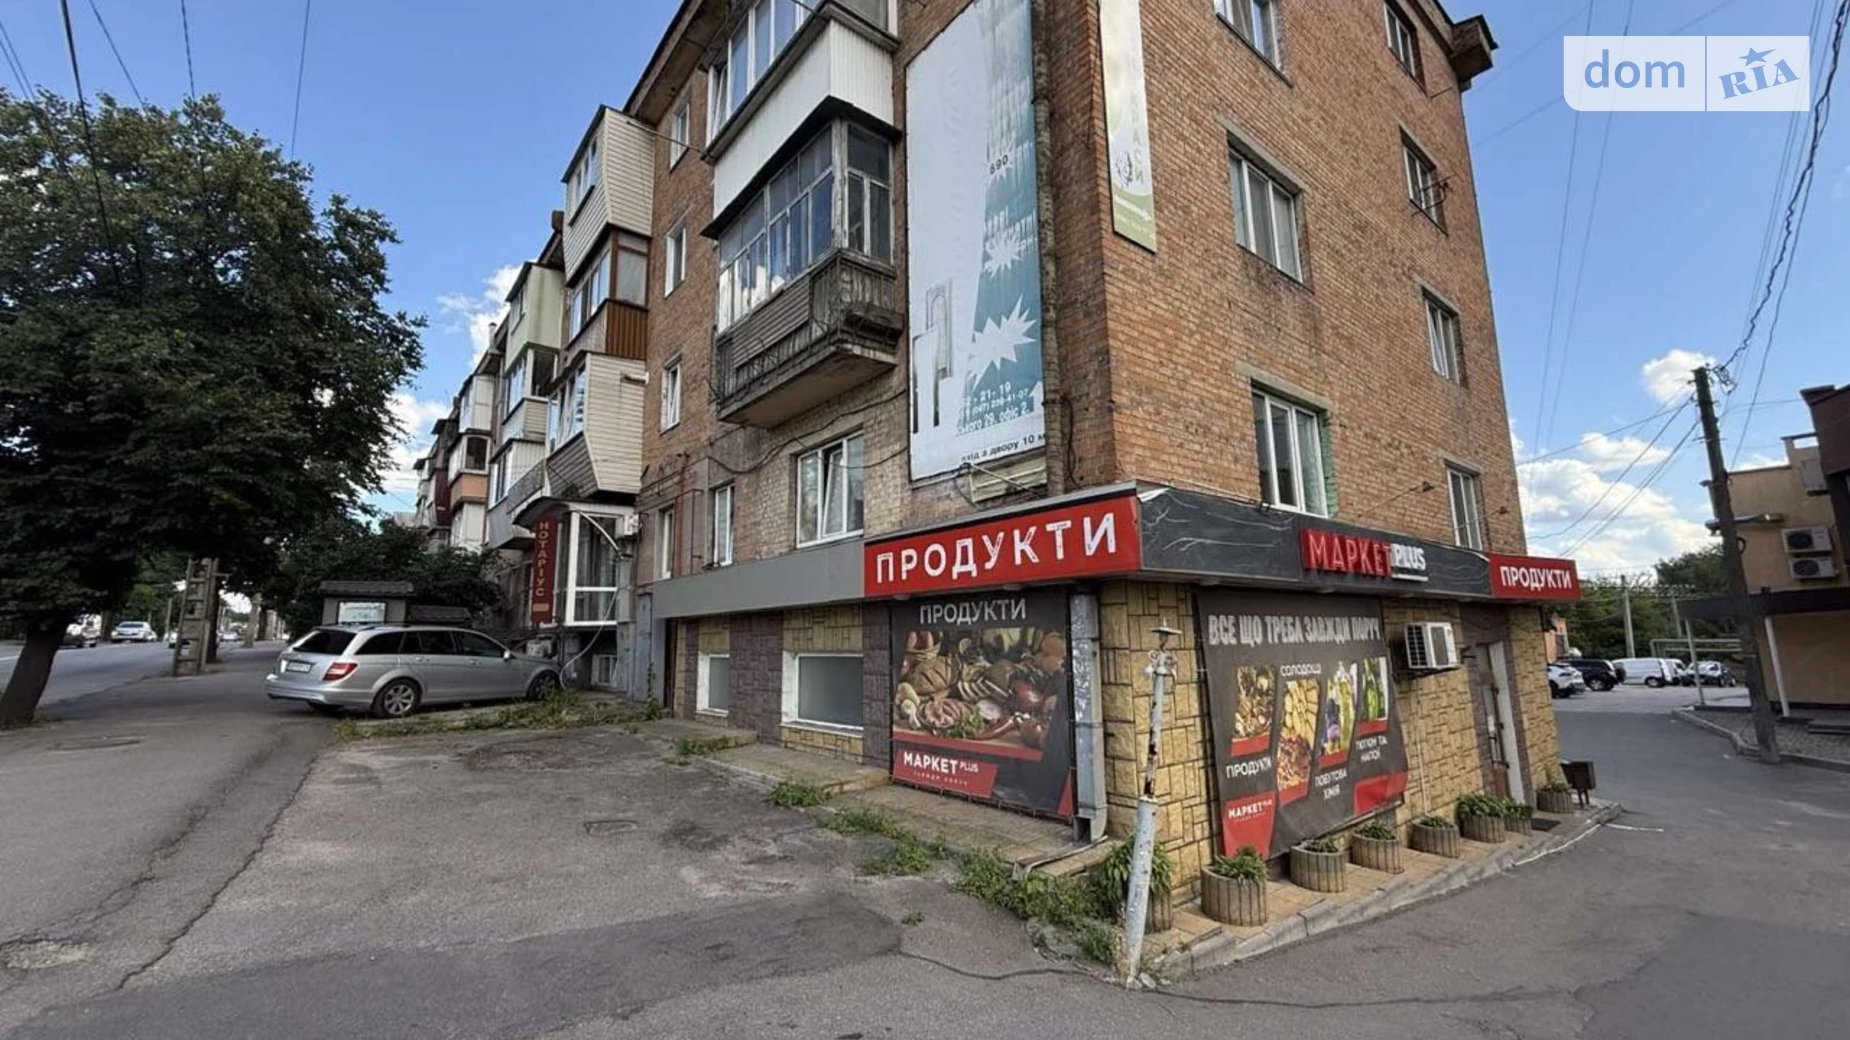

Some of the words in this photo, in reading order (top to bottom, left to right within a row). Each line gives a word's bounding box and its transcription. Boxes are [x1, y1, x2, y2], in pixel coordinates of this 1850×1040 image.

[1022, 434, 1035, 446] 10
[535, 521, 549, 597] НОТАРІУС
[876, 512, 1116, 584] ПРОДУКТИ
[1306, 530, 1391, 576] МАРКЕТ
[1391, 543, 1426, 571] PLUS
[1500, 565, 1572, 591] ПРОДУКТИ
[919, 597, 1027, 625] ПРОДУКТИ
[1208, 614, 1237, 645] ВСЕ
[1239, 614, 1263, 648] ЩО
[1265, 615, 1304, 645] ТРЕБА
[1304, 616, 1351, 645] ЗАВЖДИ
[903, 751, 958, 775] МАРКЕТ
[959, 761, 979, 773] PLUS
[1226, 757, 1272, 779] ПРОДУКТИ
[1228, 801, 1263, 820] МАРКЕТ
